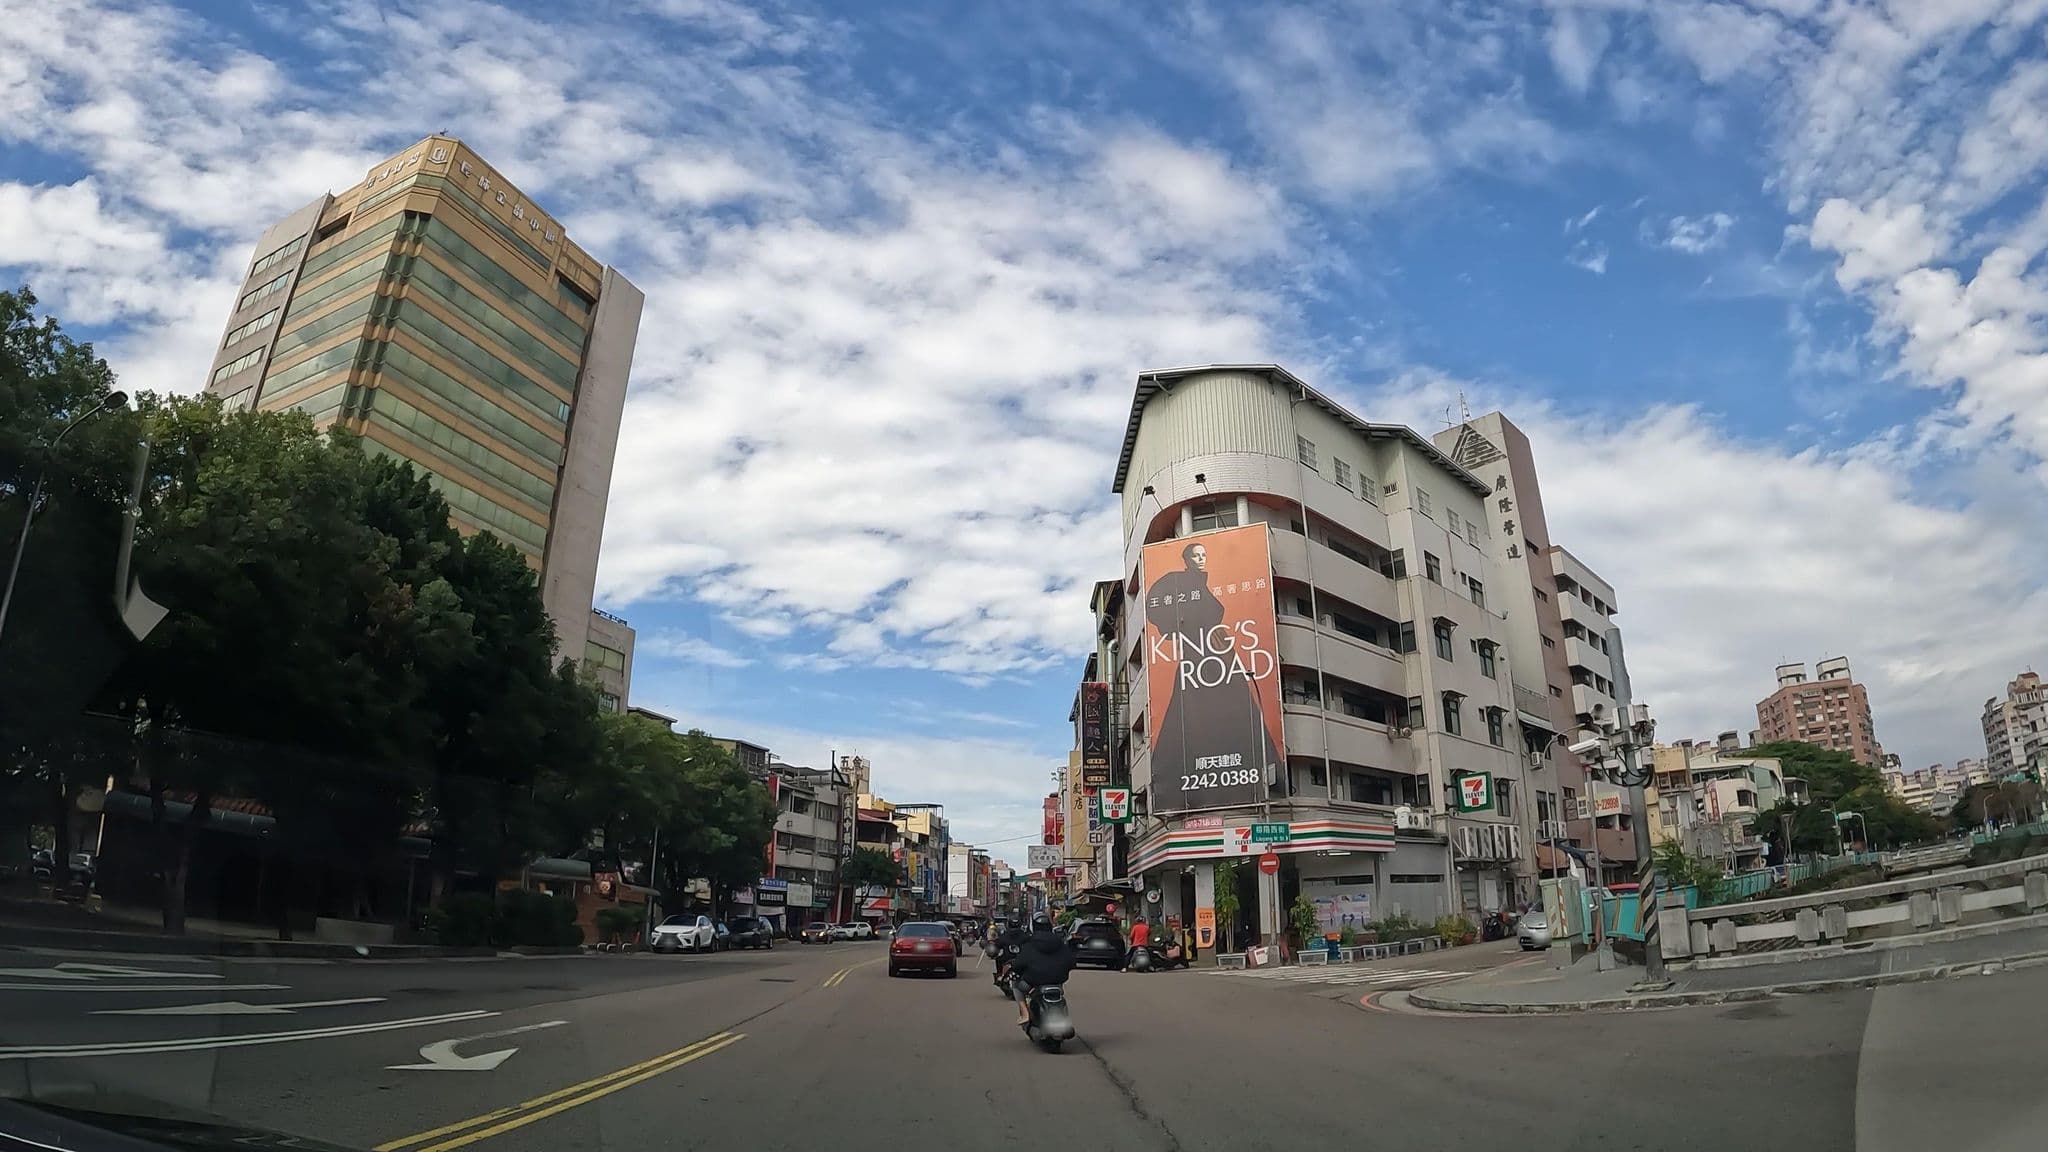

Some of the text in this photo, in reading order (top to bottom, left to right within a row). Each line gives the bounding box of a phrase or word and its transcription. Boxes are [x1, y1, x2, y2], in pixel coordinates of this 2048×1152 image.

[1495, 474, 1522, 559] 廣隆營造
[1150, 589, 1201, 608] 王者之路
[1151, 619, 1259, 665] KING'S
[1180, 649, 1274, 691] ROAD
[1195, 753, 1242, 770] 順天建設
[1181, 768, 1259, 791] 2242 0388
